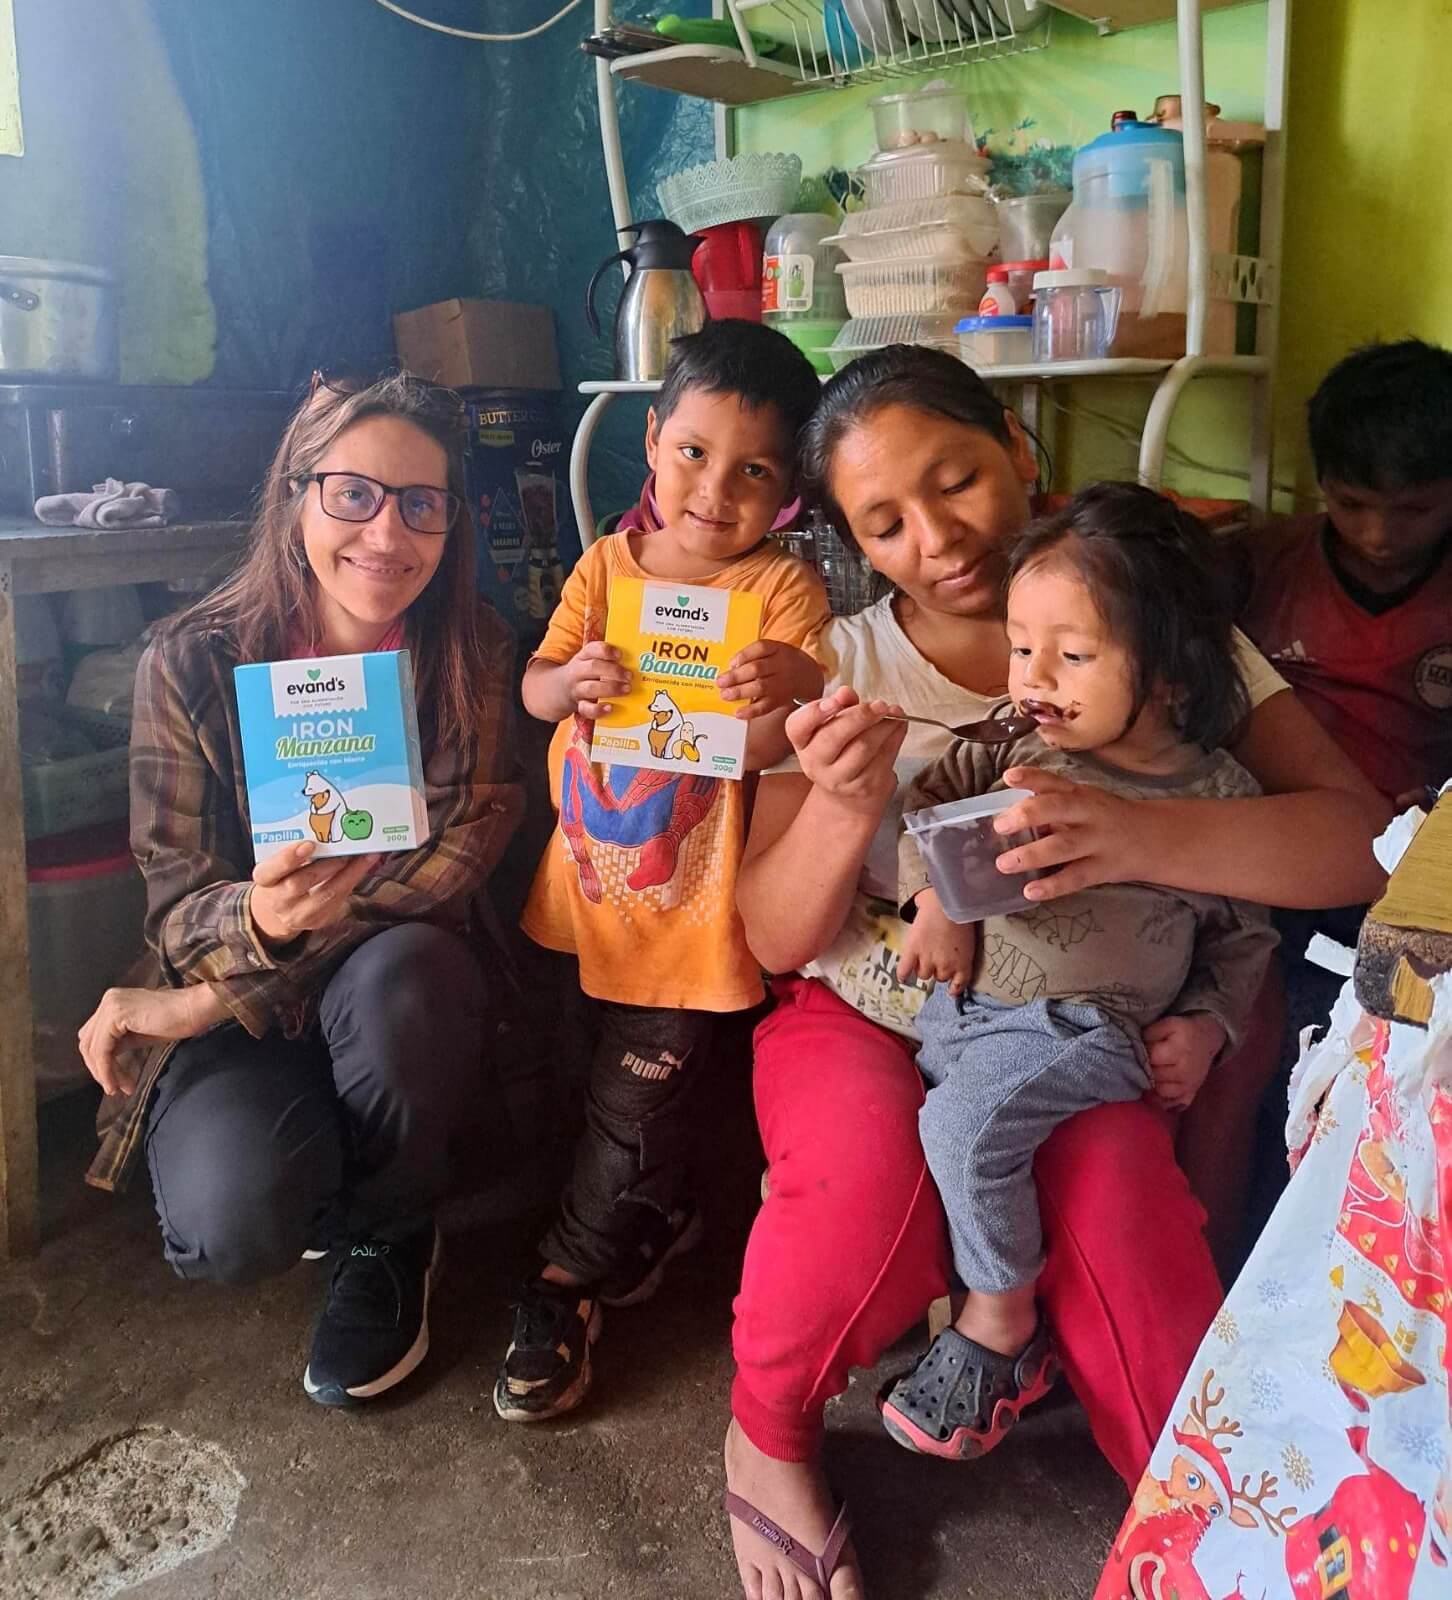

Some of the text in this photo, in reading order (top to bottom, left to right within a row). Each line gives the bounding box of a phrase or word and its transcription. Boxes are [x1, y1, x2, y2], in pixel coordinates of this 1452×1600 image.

[531, 439, 562, 458] Oster
[655, 605, 709, 622] evand's
[652, 640, 709, 662] IRON
[639, 652, 719, 681] Banana
[287, 677, 345, 695] evand's
[292, 718, 353, 740] IRON
[276, 734, 376, 759] Manzana
[600, 737, 636, 749] Papilla
[713, 763, 734, 774] 200g
[260, 832, 300, 844] Papilla
[386, 834, 408, 842] 200g
[621, 1051, 672, 1080] PUMA
